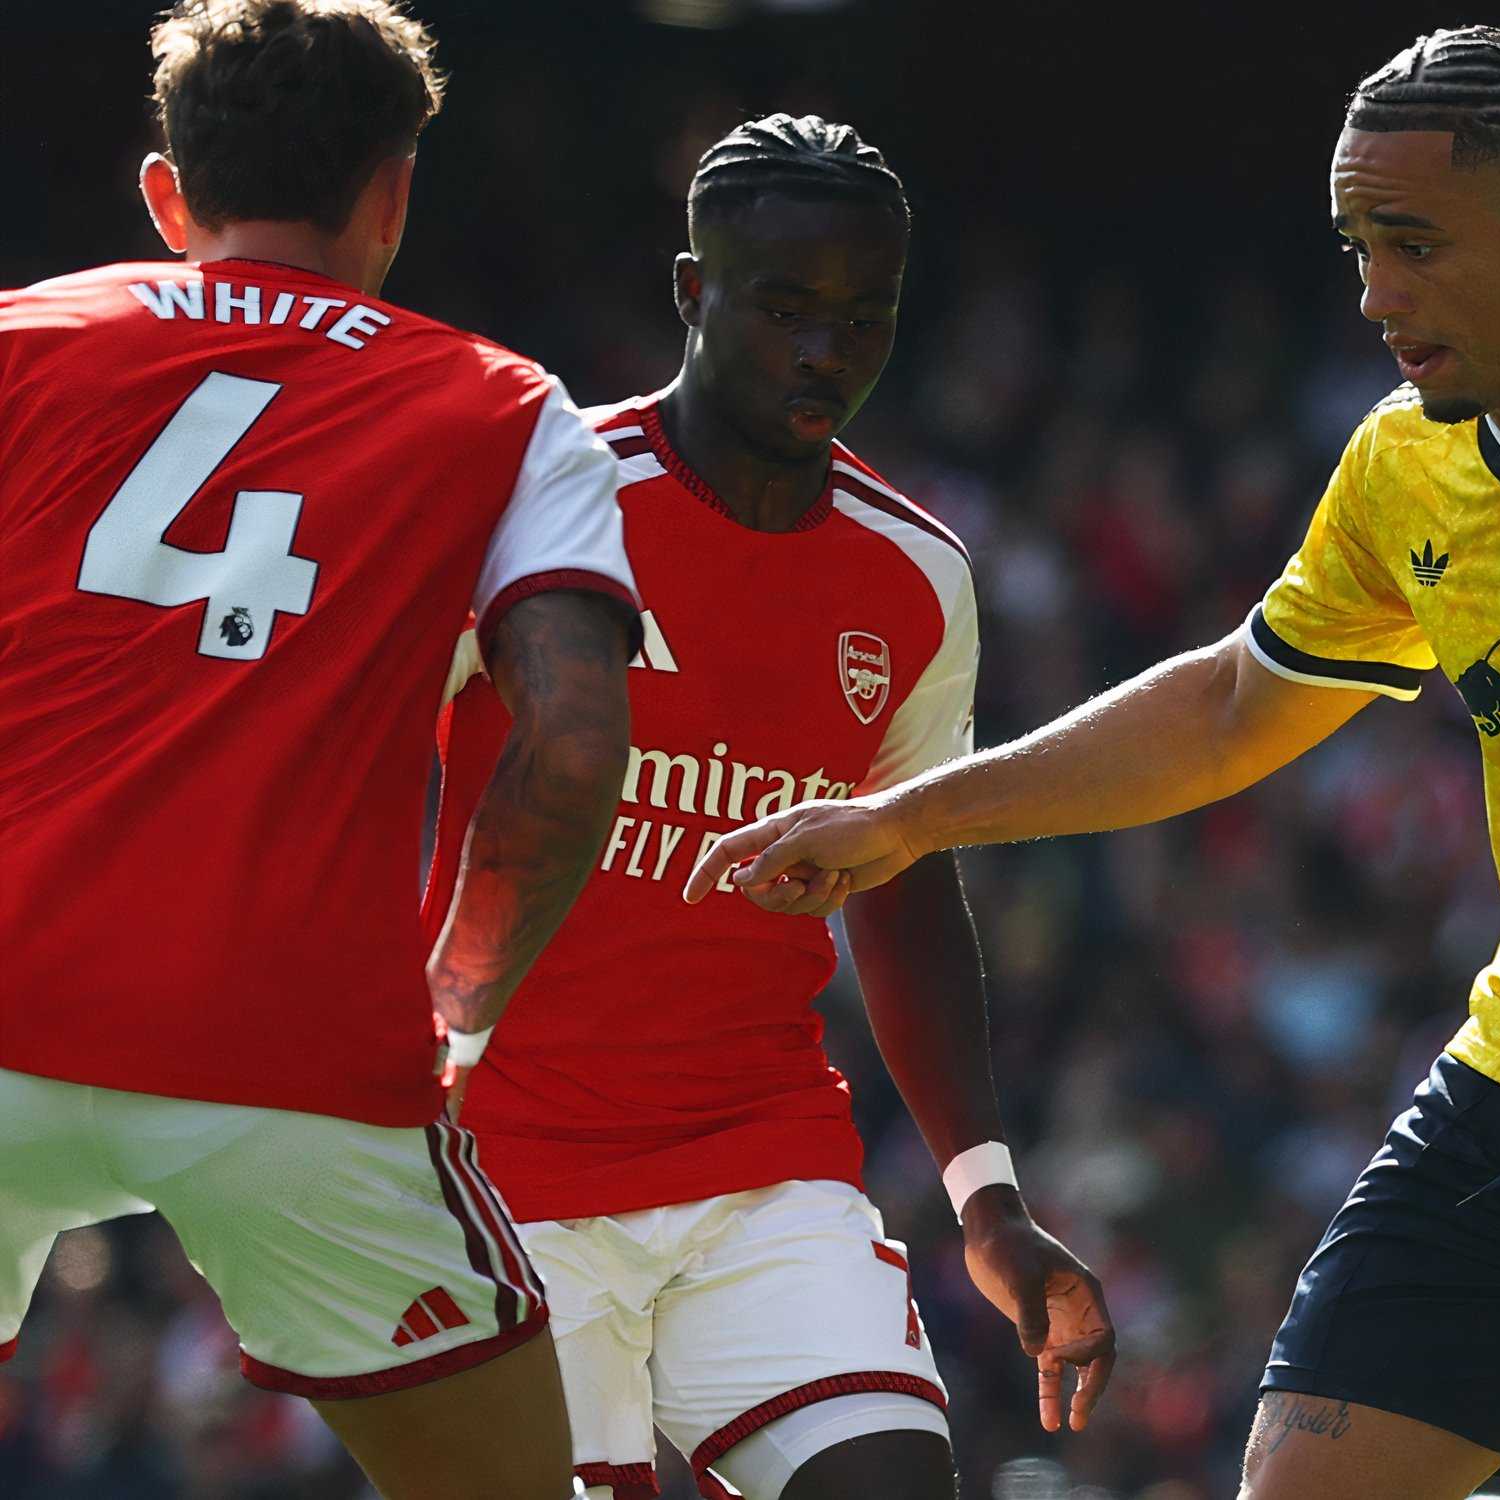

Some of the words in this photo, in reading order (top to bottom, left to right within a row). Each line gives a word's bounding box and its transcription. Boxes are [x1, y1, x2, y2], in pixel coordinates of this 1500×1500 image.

[129, 278, 391, 350] WHITE
[76, 370, 319, 660] 4
[620, 742, 857, 822] mirat
[600, 815, 685, 881] FLY
